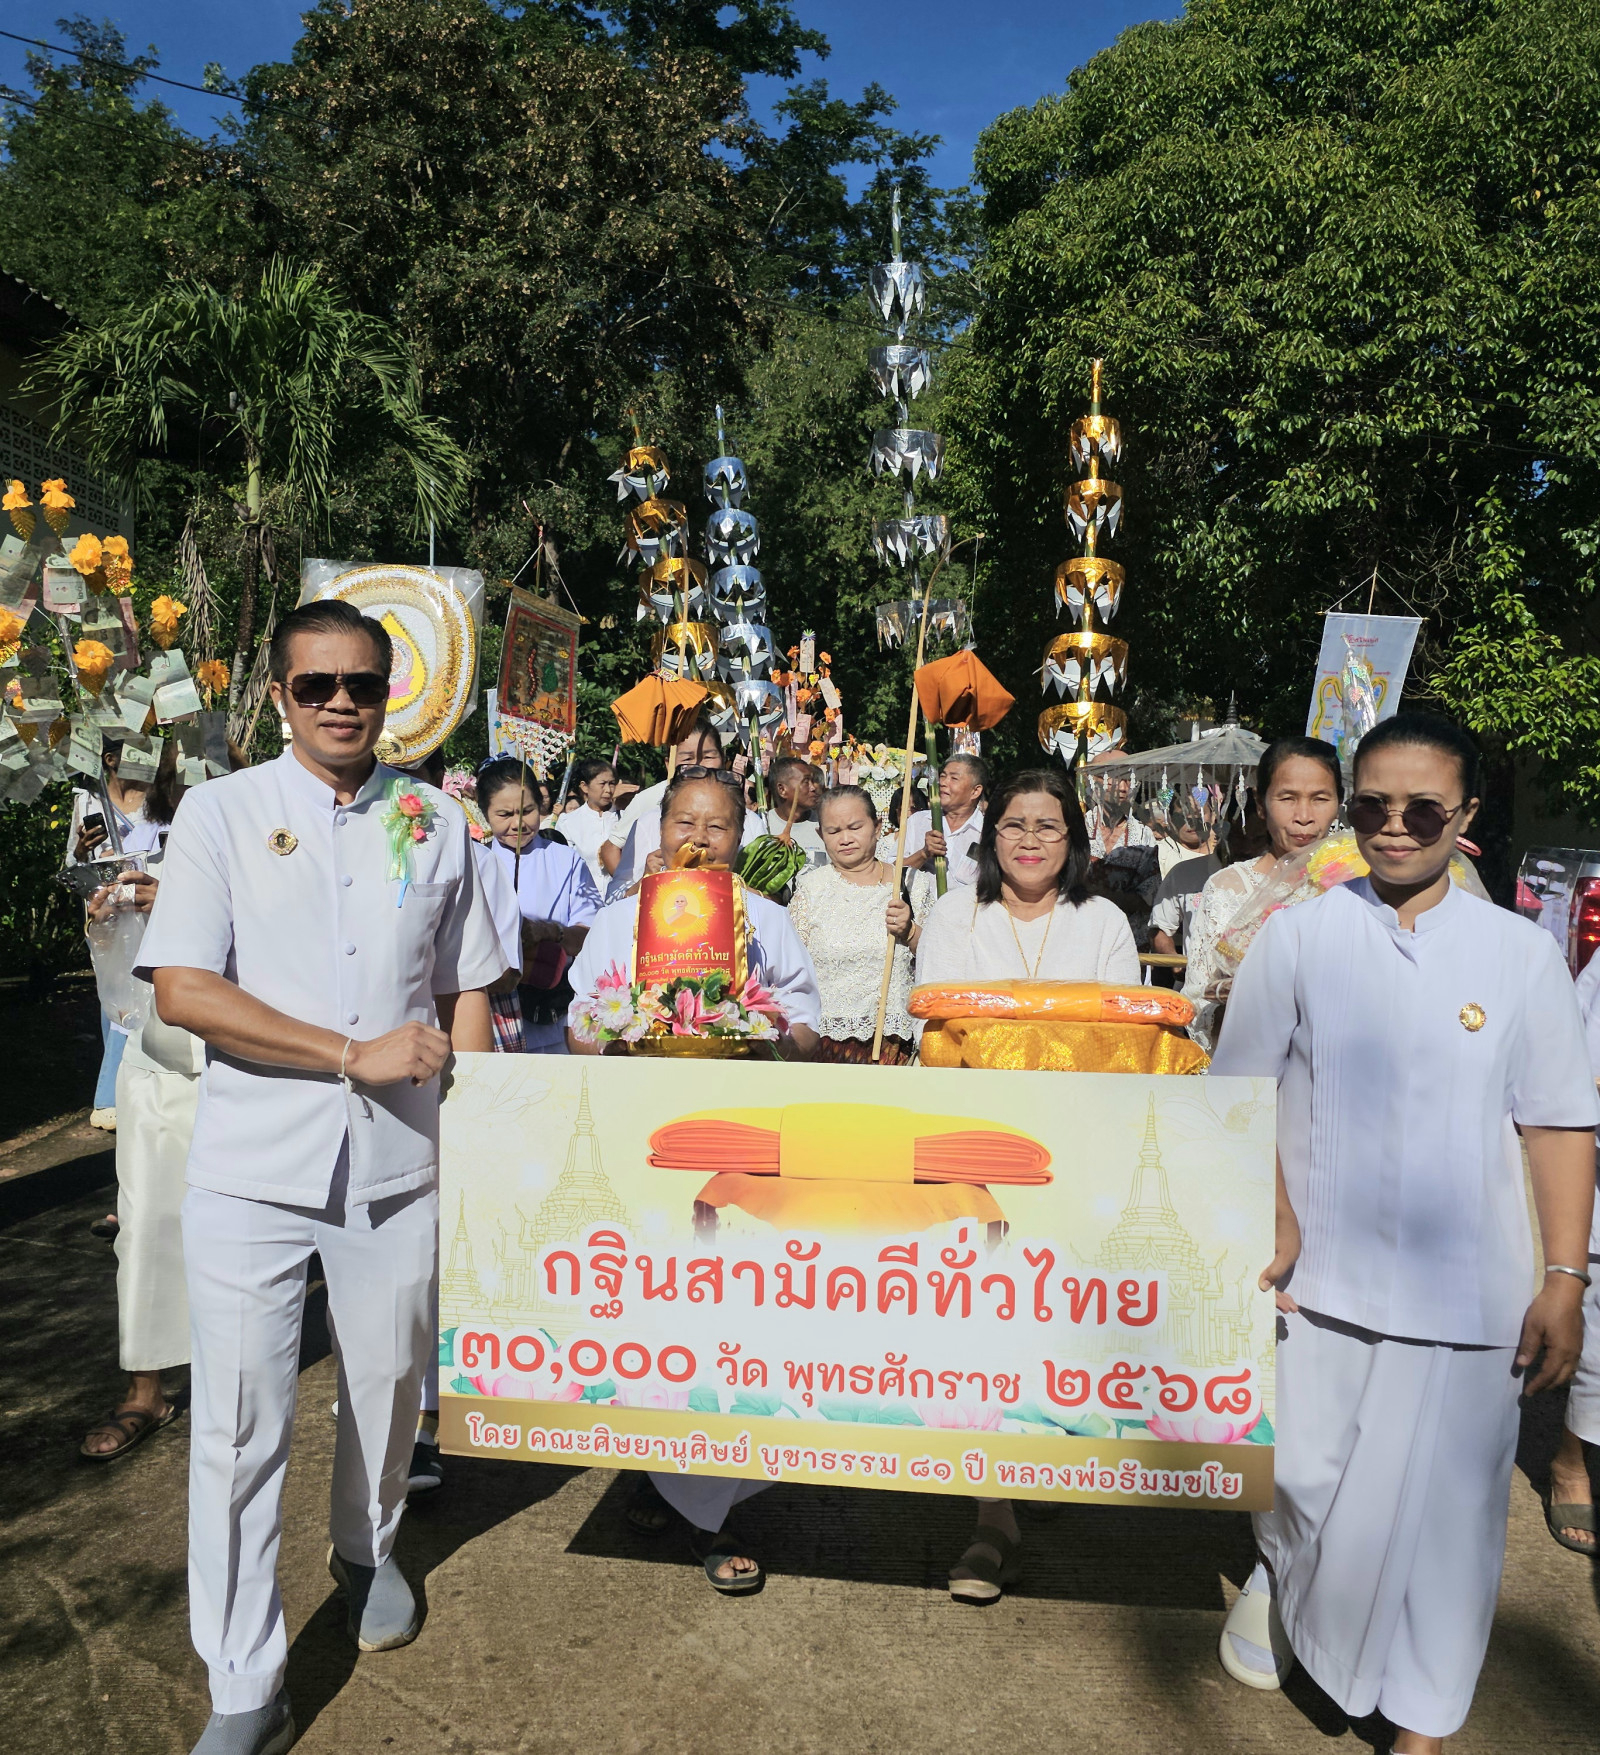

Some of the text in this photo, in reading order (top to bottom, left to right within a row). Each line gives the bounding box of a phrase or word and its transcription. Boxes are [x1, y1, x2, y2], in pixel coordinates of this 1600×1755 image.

[543, 1227, 1159, 1327] กฐินสามัคคีทั่วไทย
[462, 1331, 1252, 1415] ๓๐,๐๐๐ วัด พุทธศักราช ๒๕๖๘
[469, 1415, 1239, 1496] โดย คณะศิษยานุศิษย์ บูชาธรรม ๘๑ ปี หลวงพ่อธัมมชโย
